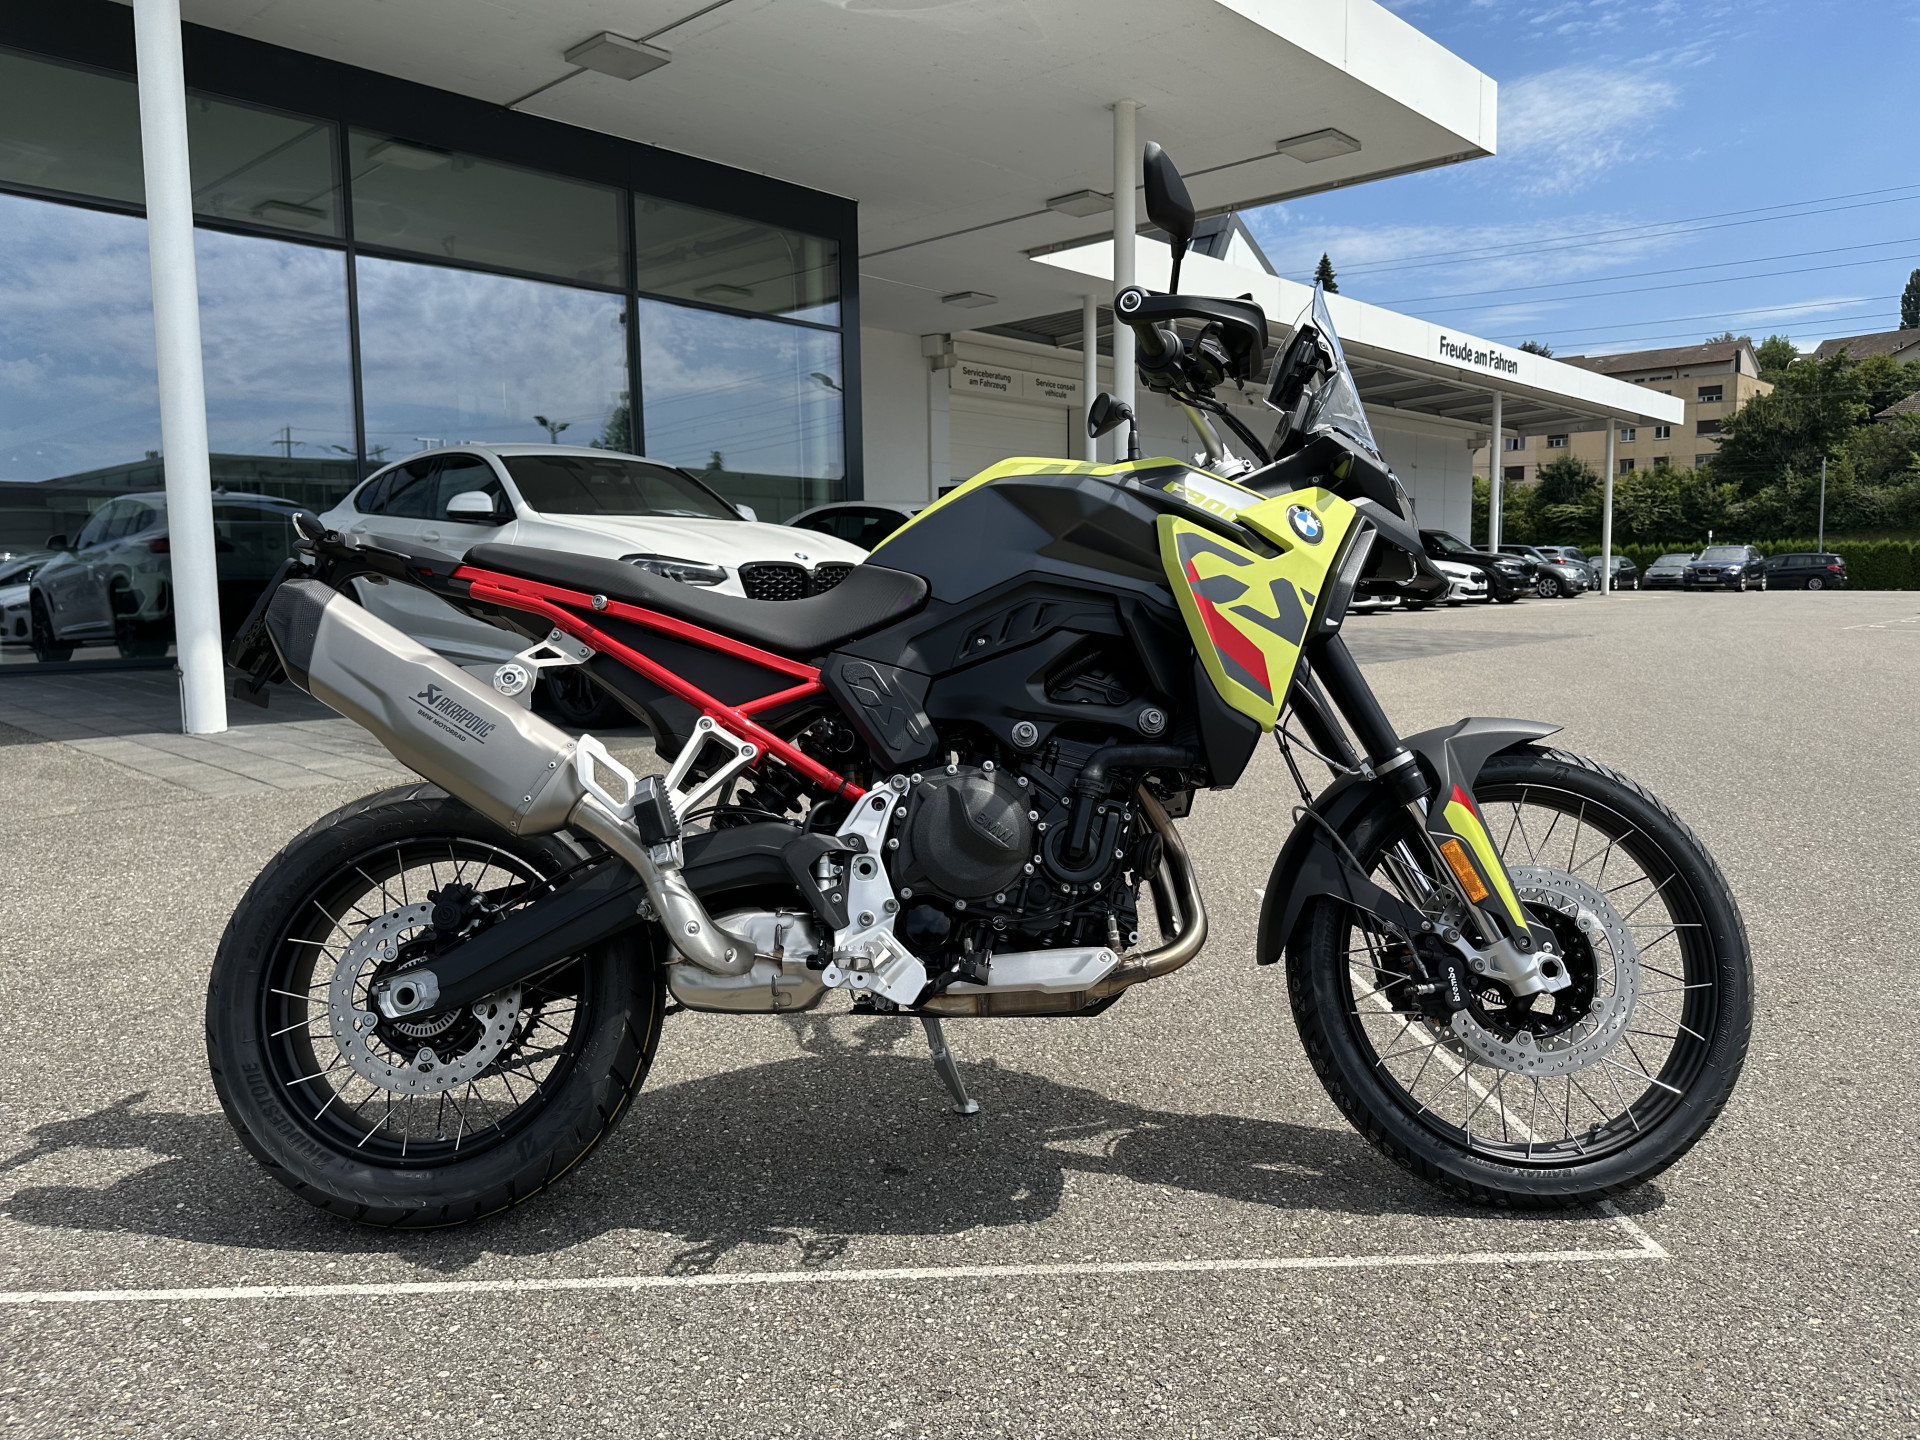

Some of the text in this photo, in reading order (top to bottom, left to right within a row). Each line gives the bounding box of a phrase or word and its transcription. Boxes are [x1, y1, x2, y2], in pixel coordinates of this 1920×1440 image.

[1440, 335, 1518, 375] Freude am Fahren
[962, 366, 1012, 384] Serviceberatung
[969, 378, 1007, 391] am Fahrzeug
[1035, 378, 1076, 392] Service conseil
[1045, 389, 1067, 398] véhicule
[417, 708, 434, 721] BMW
[432, 719, 467, 742] MOTORRAD
[975, 811, 1014, 843] BMW
[1447, 966, 1461, 1002] brembo
[242, 1062, 337, 1170] BRIDGESTONE
